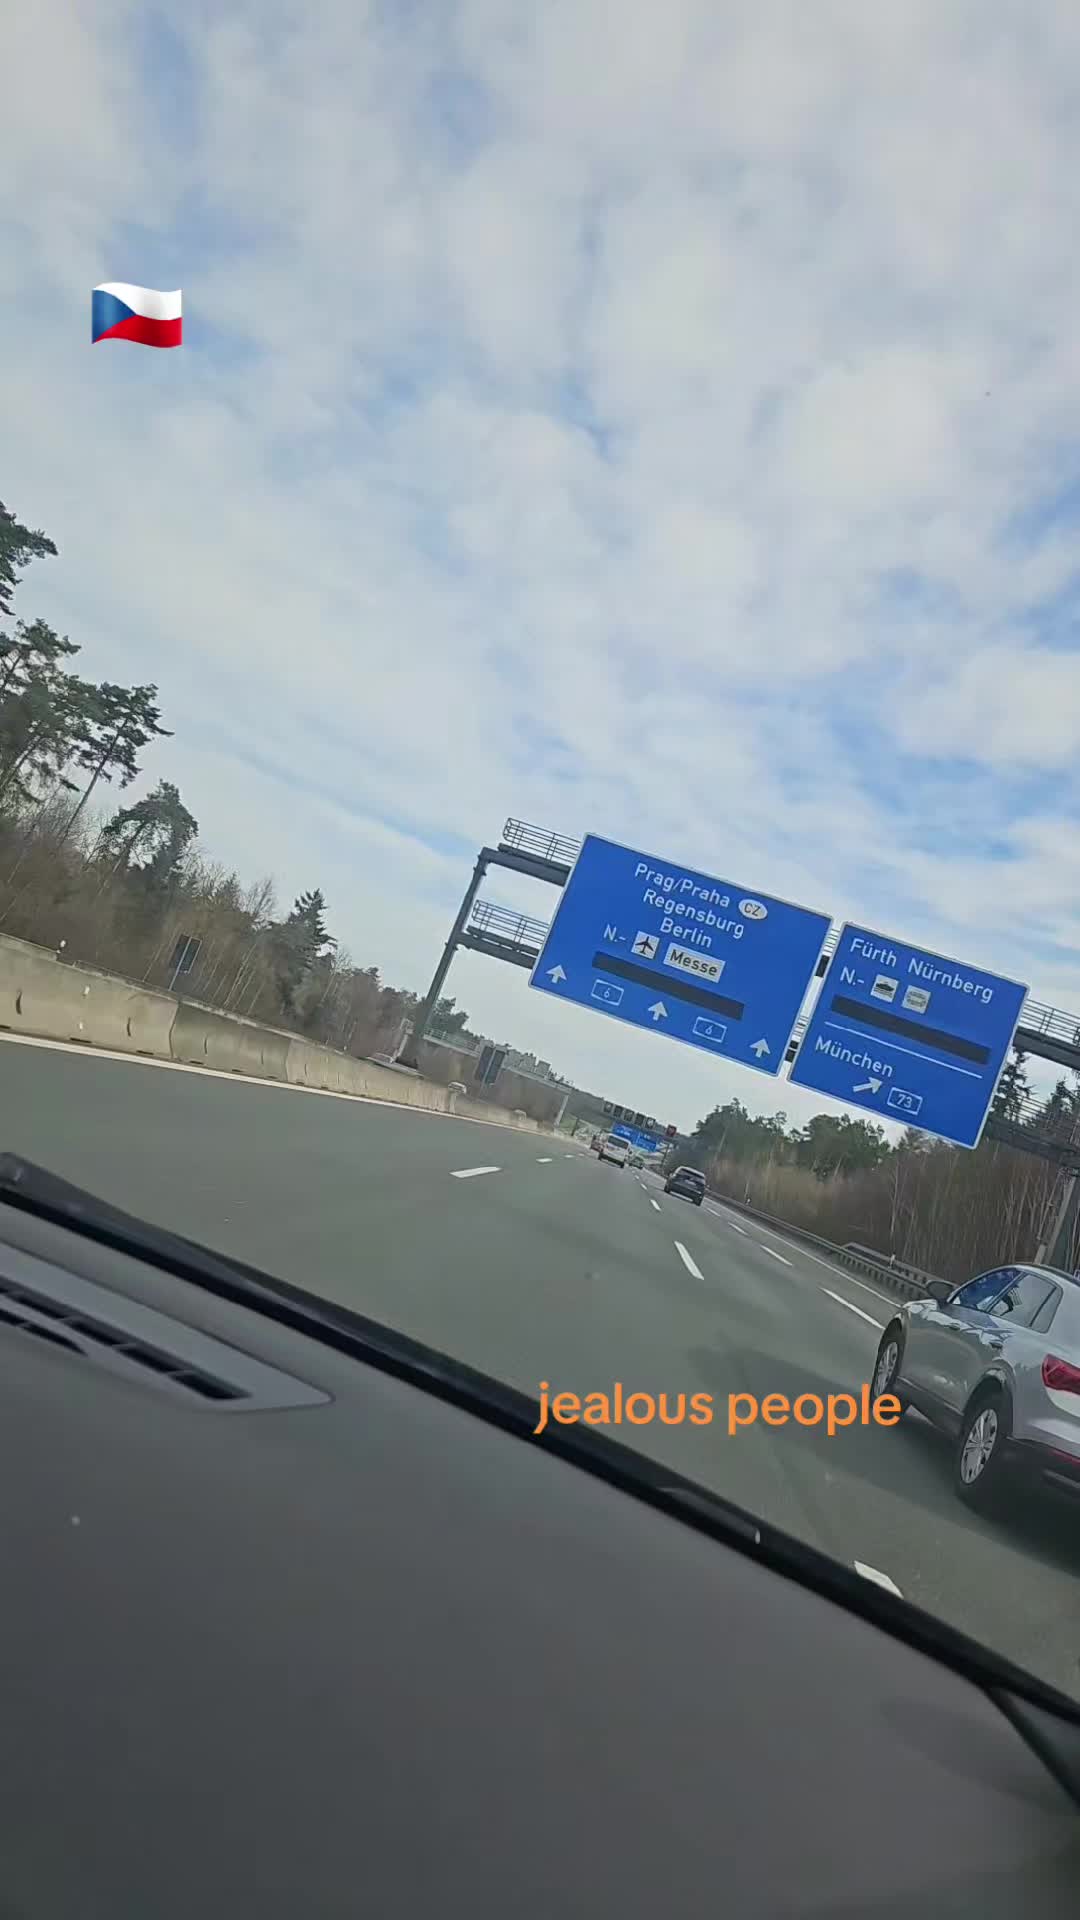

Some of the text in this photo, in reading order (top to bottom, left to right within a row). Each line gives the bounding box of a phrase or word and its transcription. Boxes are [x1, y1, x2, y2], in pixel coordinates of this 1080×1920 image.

[634, 862, 761, 917] Prag/Praha CZ
[643, 888, 745, 939] Regensburg
[659, 917, 713, 948] Berlin
[669, 949, 718, 976] Messe
[849, 937, 993, 1004] Fürth Nürnberg
[815, 1035, 893, 1078] München
[896, 1093, 913, 1108] 73
